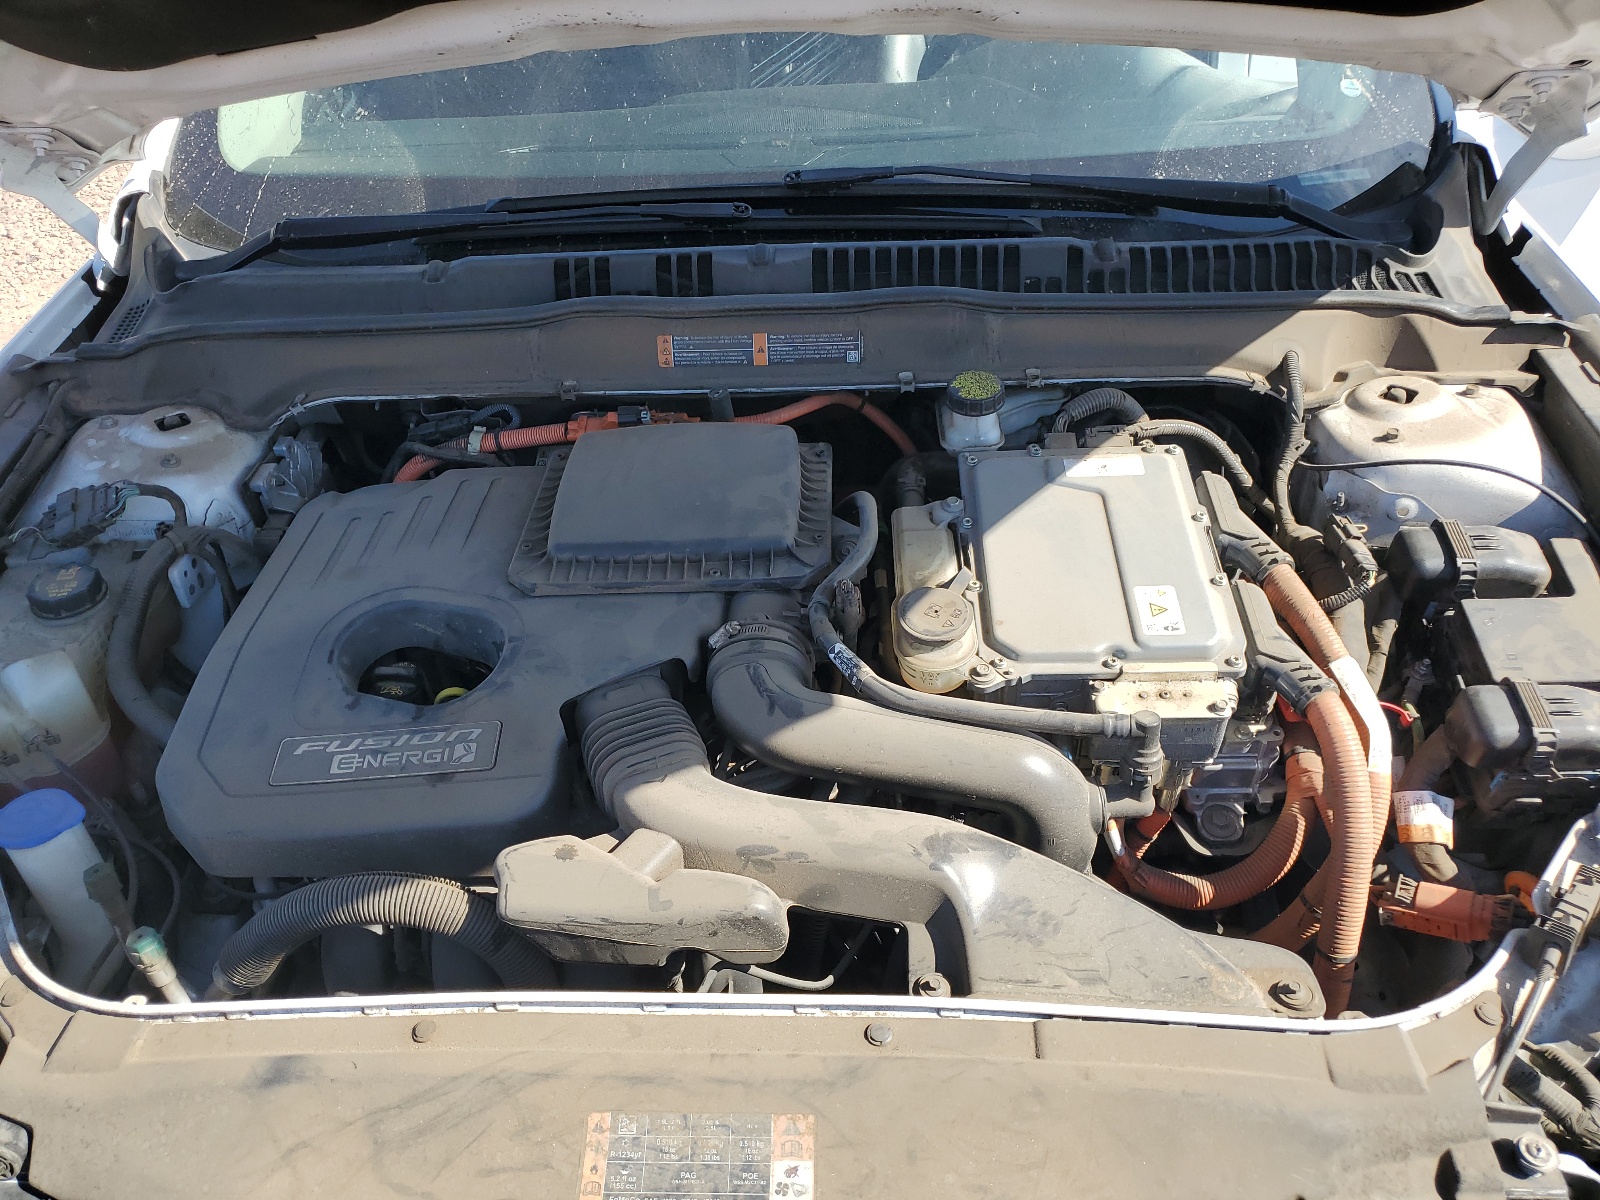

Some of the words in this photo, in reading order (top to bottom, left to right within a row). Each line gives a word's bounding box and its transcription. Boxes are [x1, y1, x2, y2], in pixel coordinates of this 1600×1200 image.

[293, 728, 483, 755] FUSION
[329, 747, 450, 774] ENERGI
[610, 1151, 642, 1160] R-1234yf
